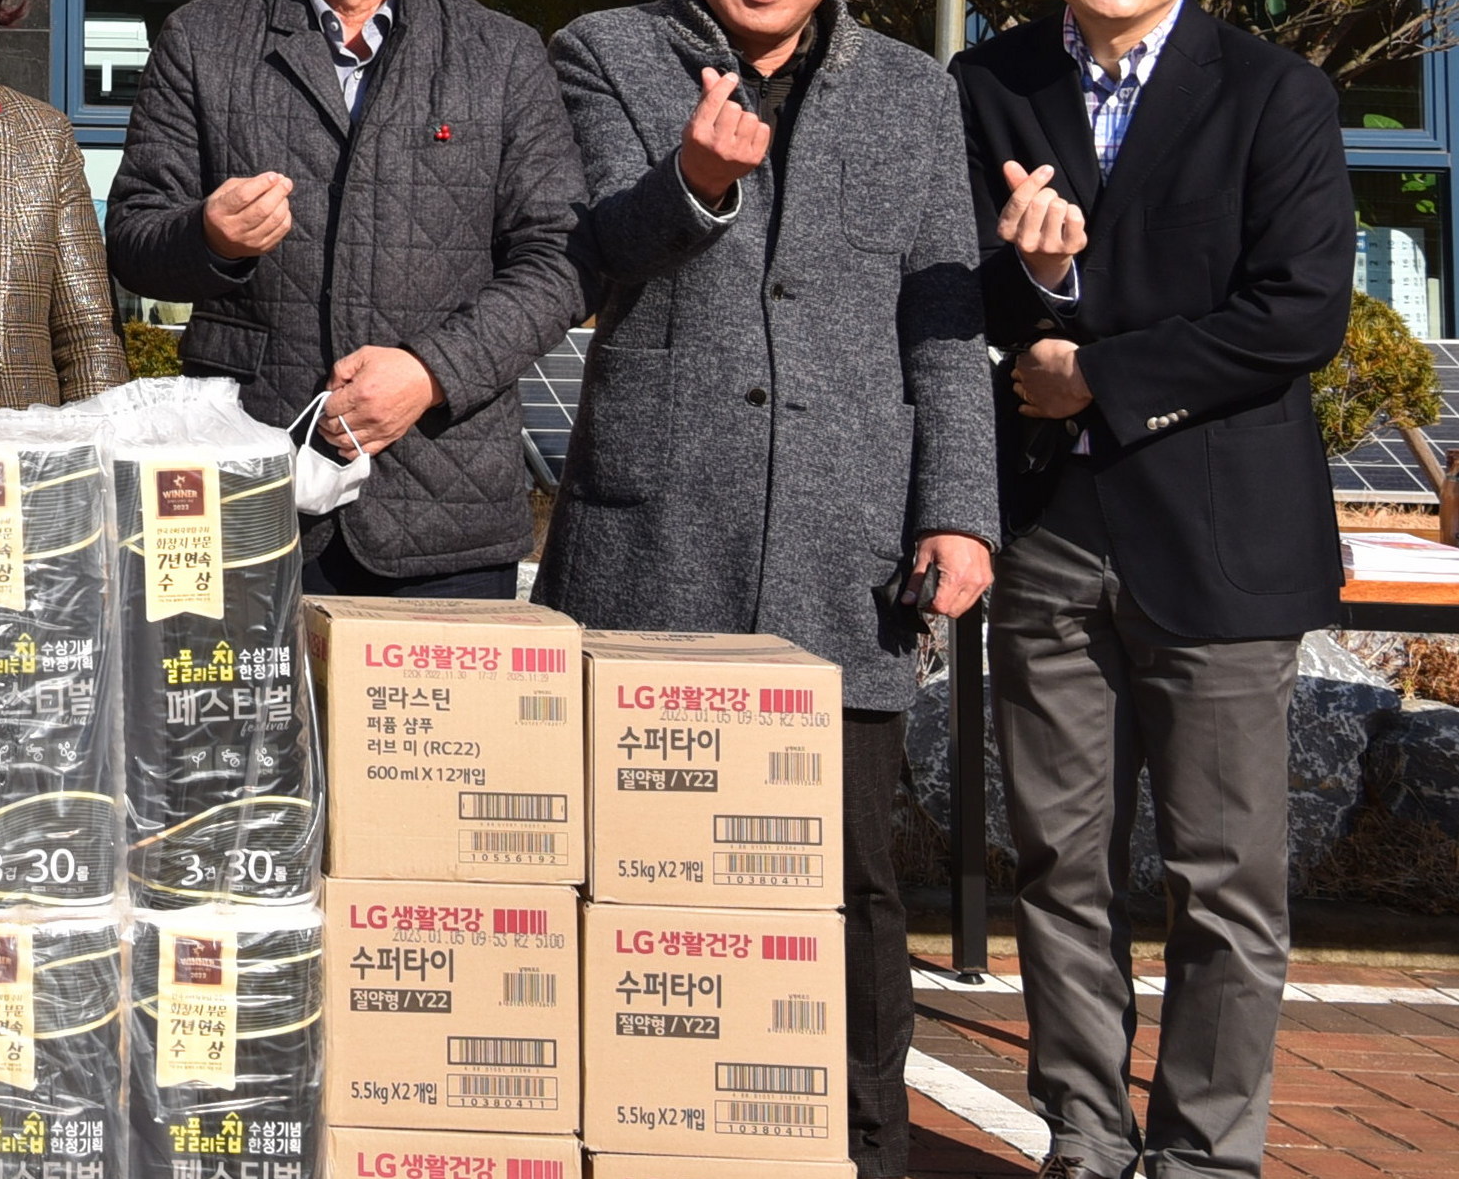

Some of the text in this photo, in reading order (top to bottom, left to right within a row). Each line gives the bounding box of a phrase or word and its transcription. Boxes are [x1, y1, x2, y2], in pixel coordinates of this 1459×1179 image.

[163, 490, 197, 499] WINNER
[157, 553, 181, 569] 7년
[365, 644, 501, 671] LG 생활건강
[366, 686, 450, 710] 엘라스틴
[617, 685, 750, 712] LG 생활건강
[367, 717, 433, 735] 퍼퓸 샴푸
[367, 739, 481, 758] 러브 미 (RC22)
[617, 726, 720, 762] 수퍼타이
[620, 771, 714, 789] 절약형 Y22
[471, 854, 555, 863] 10556192
[350, 905, 484, 932] LG 생활건강
[616, 930, 752, 958] LG 생활건강
[350, 946, 453, 983] 수퍼타이
[353, 991, 448, 1010] 절약형 Y22
[616, 971, 722, 1008] 수퍼타이
[619, 1015, 716, 1035] 절약형 Y22
